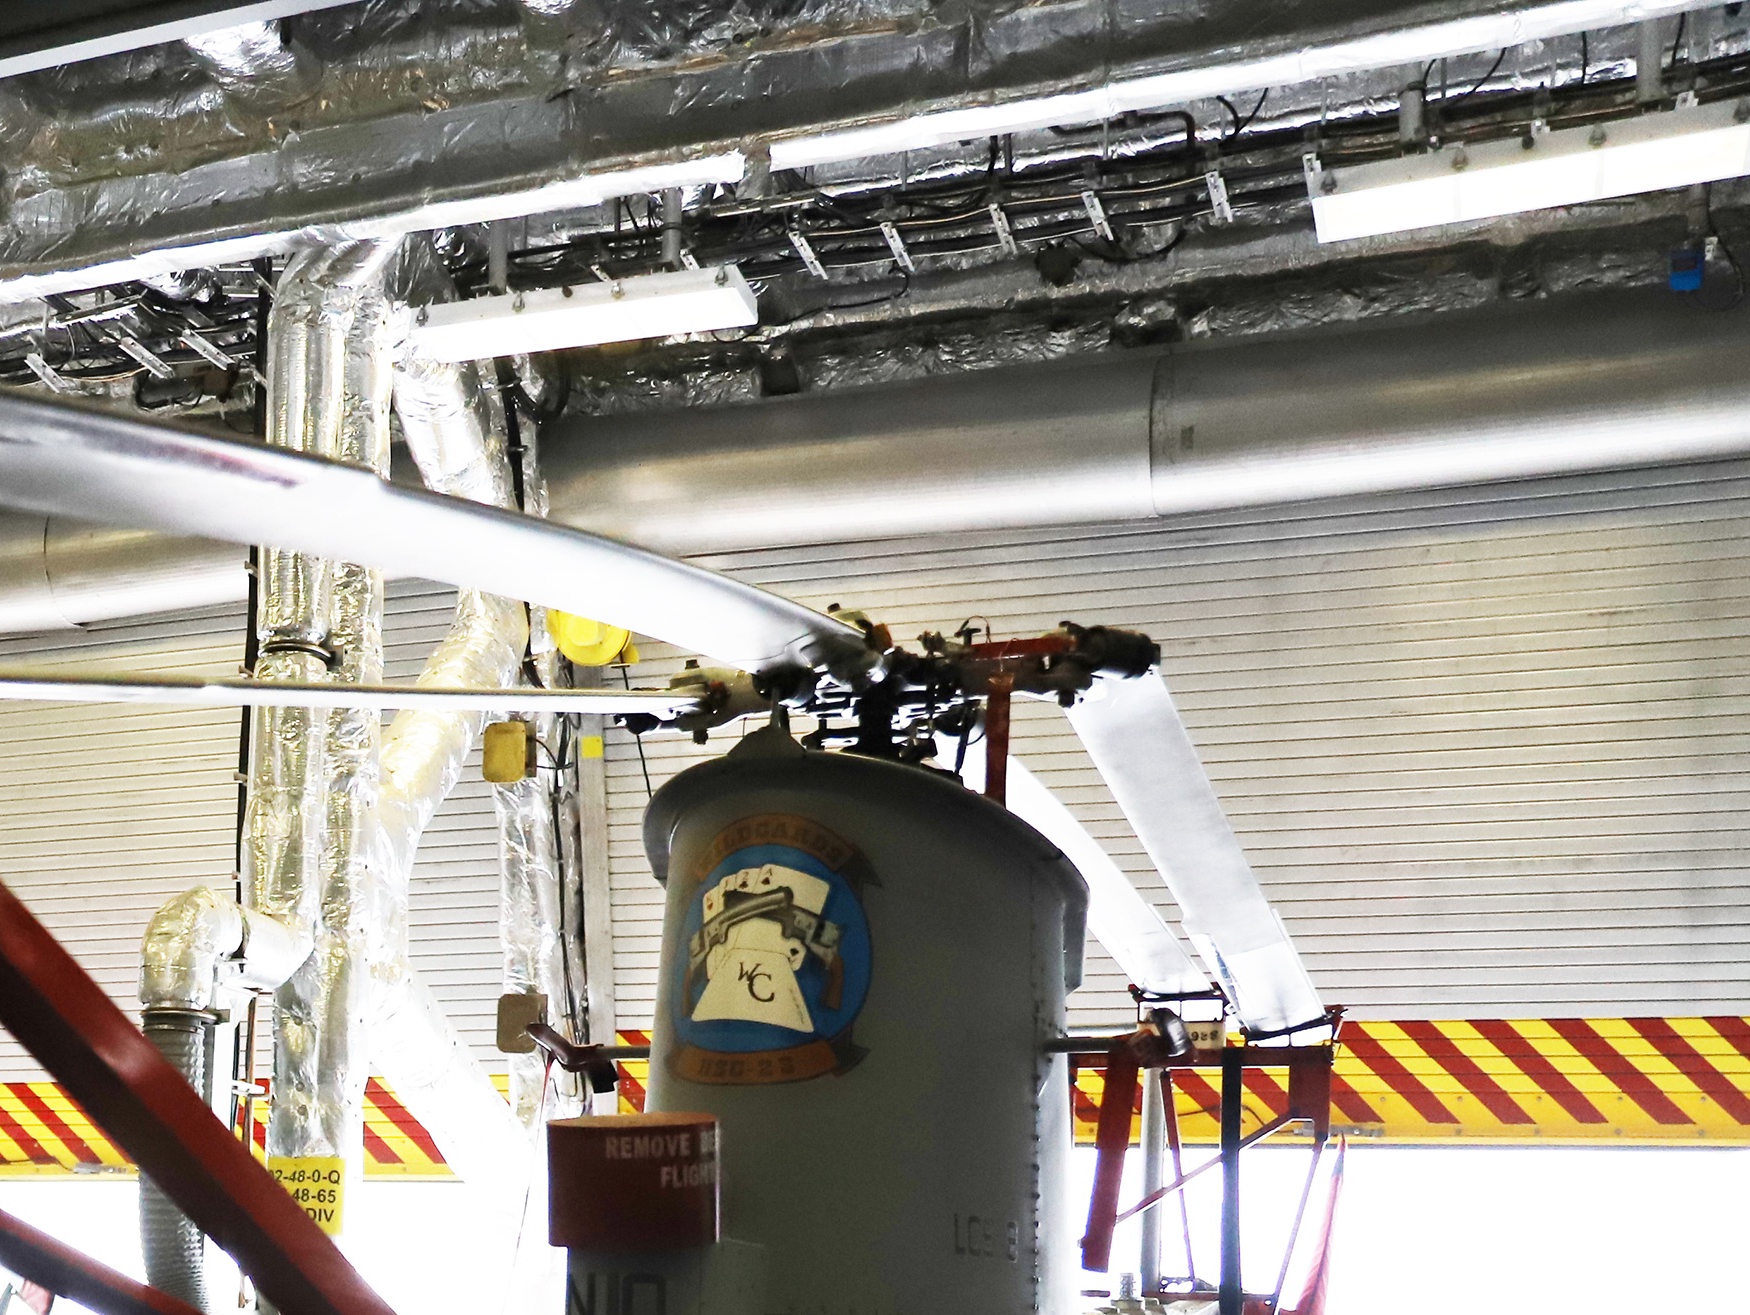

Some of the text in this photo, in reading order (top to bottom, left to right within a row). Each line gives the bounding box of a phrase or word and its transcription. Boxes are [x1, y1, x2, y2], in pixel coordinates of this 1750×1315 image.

[605, 1133, 690, 1159] REMOVE
[660, 1162, 716, 1188] FLIGHT
[305, 1208, 334, 1222] DIV
